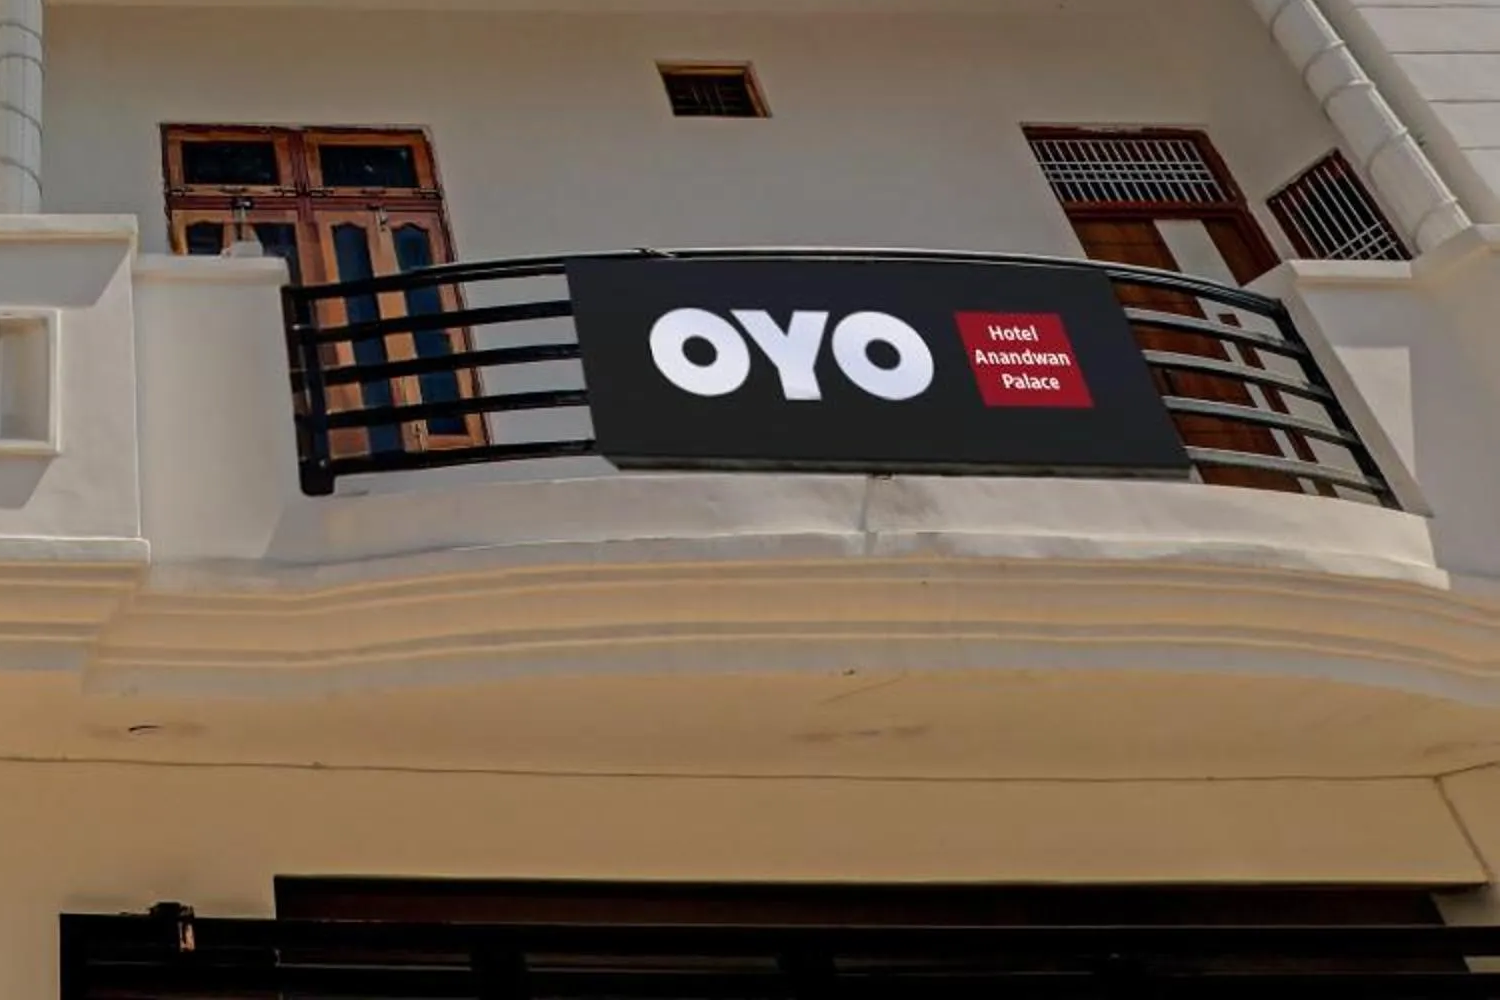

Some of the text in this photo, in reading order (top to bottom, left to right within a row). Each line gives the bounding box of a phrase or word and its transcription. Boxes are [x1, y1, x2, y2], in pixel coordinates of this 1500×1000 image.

[987, 325, 1039, 342] Hotel
[649, 307, 934, 401] OYO
[975, 348, 1071, 366] Anandwan
[1001, 372, 1060, 390] Palace
